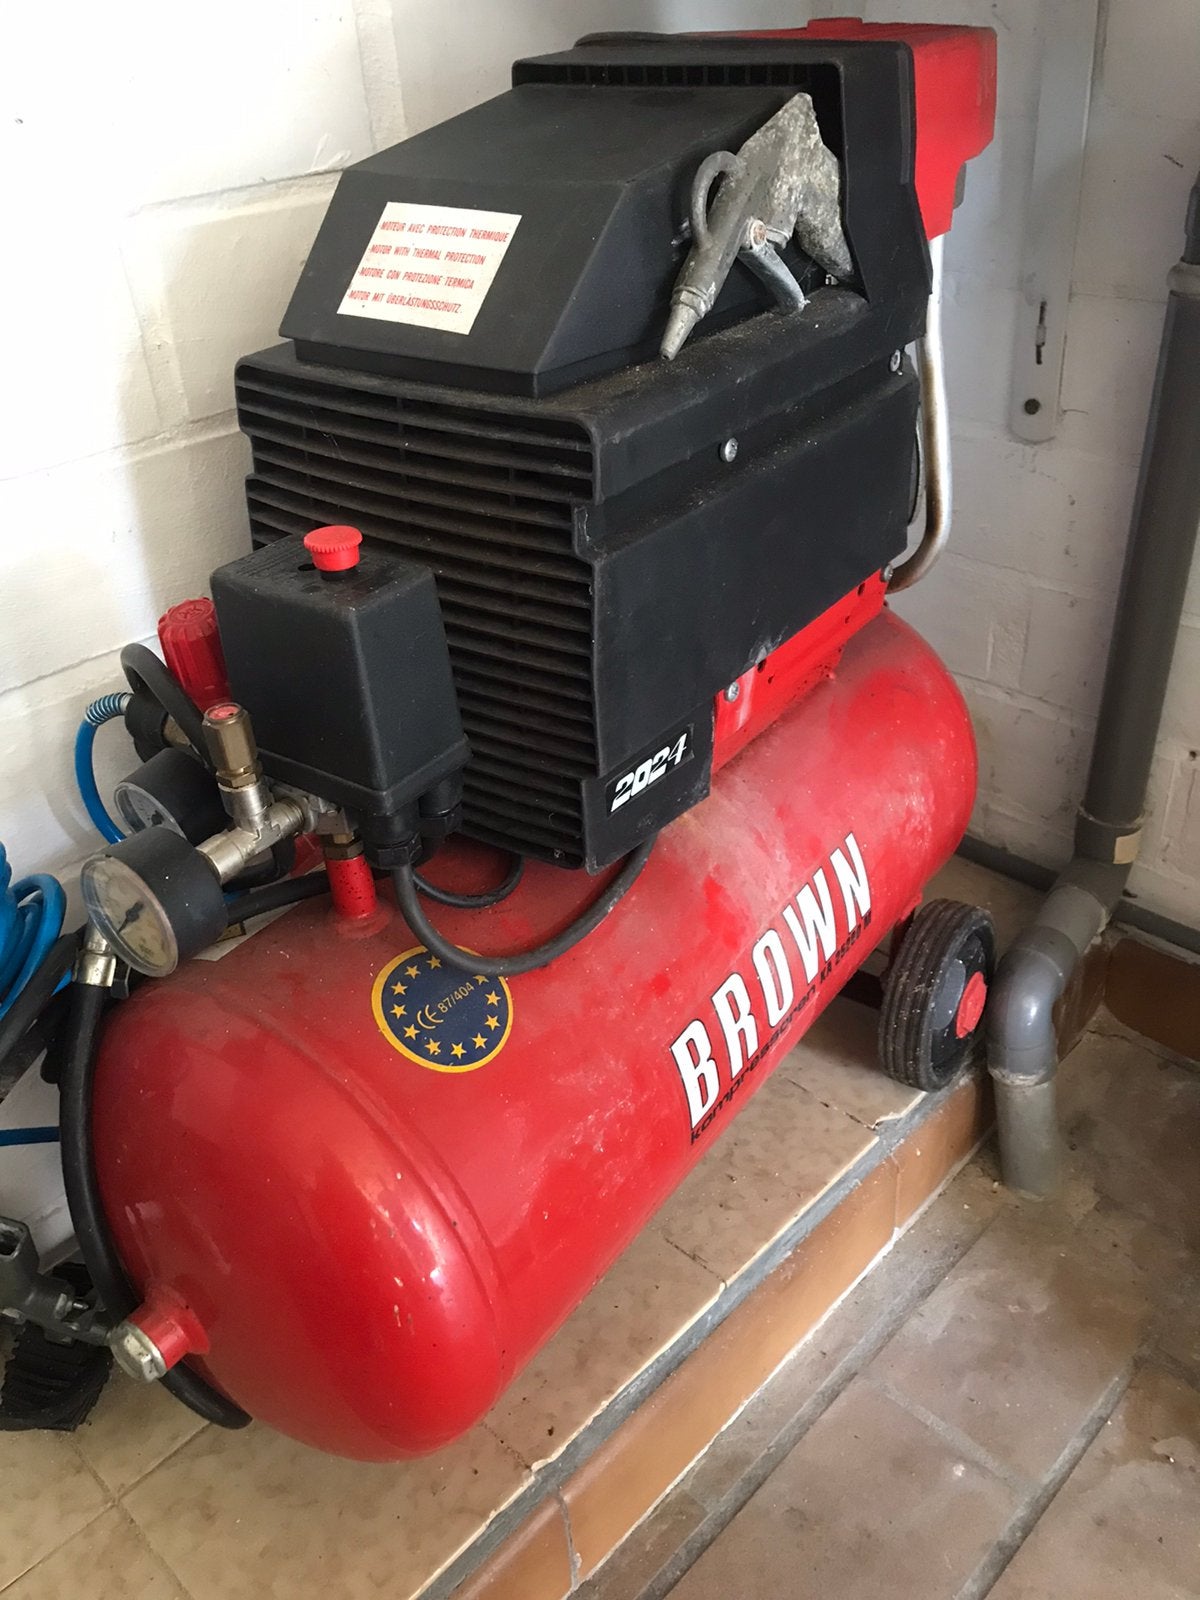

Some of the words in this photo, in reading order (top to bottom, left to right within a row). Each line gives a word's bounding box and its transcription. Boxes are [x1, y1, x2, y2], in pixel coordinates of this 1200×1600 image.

[407, 223, 425, 234] AVEC
[427, 224, 467, 238] PROTECTION
[469, 228, 510, 242] THERMIQUE
[394, 246, 410, 256] WITH
[412, 248, 441, 260] THERMAL
[444, 251, 486, 265] PROTECTION
[386, 270, 401, 280] CON
[402, 271, 442, 285] PROTEZIONE
[444, 276, 475, 289] TERMICA
[372, 292, 385, 302] MIT
[611, 733, 687, 812] 2024
[669, 832, 871, 1130] BROWN
[437, 982, 475, 1013] 87/404
